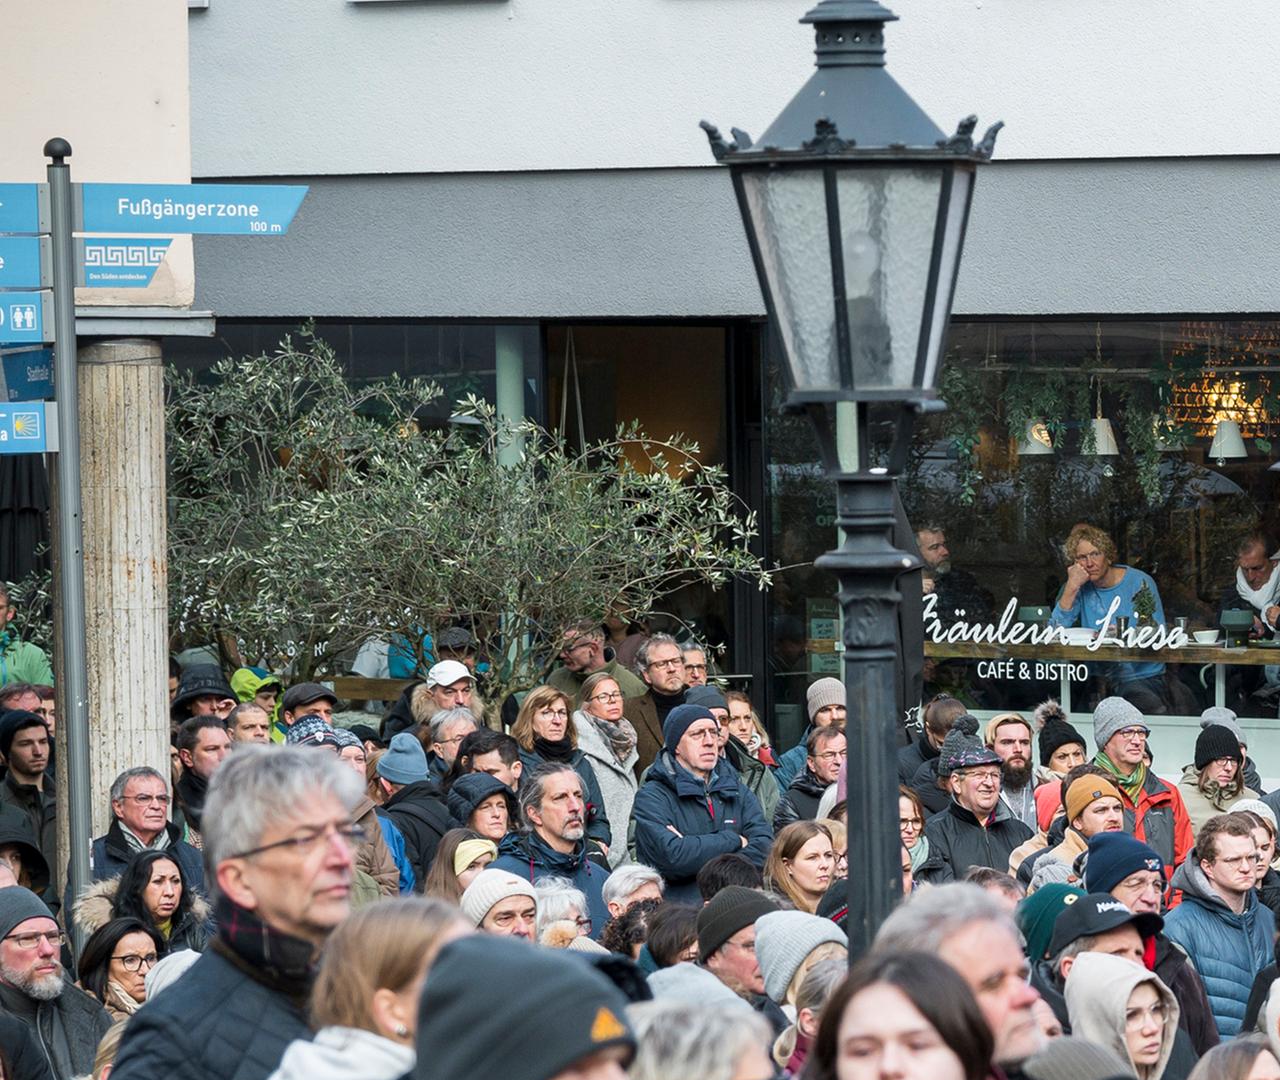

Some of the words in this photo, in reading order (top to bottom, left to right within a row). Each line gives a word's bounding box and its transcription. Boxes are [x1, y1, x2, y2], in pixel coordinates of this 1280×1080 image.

[118, 198, 260, 221] Fußgängerzone
[250, 221, 267, 232] 100
[270, 224, 281, 232] m
[1086, 595, 1189, 651] Liese
[977, 657, 1014, 680] CAFÉ
[1018, 663, 1031, 680] &
[1035, 663, 1089, 682] BISTRO
